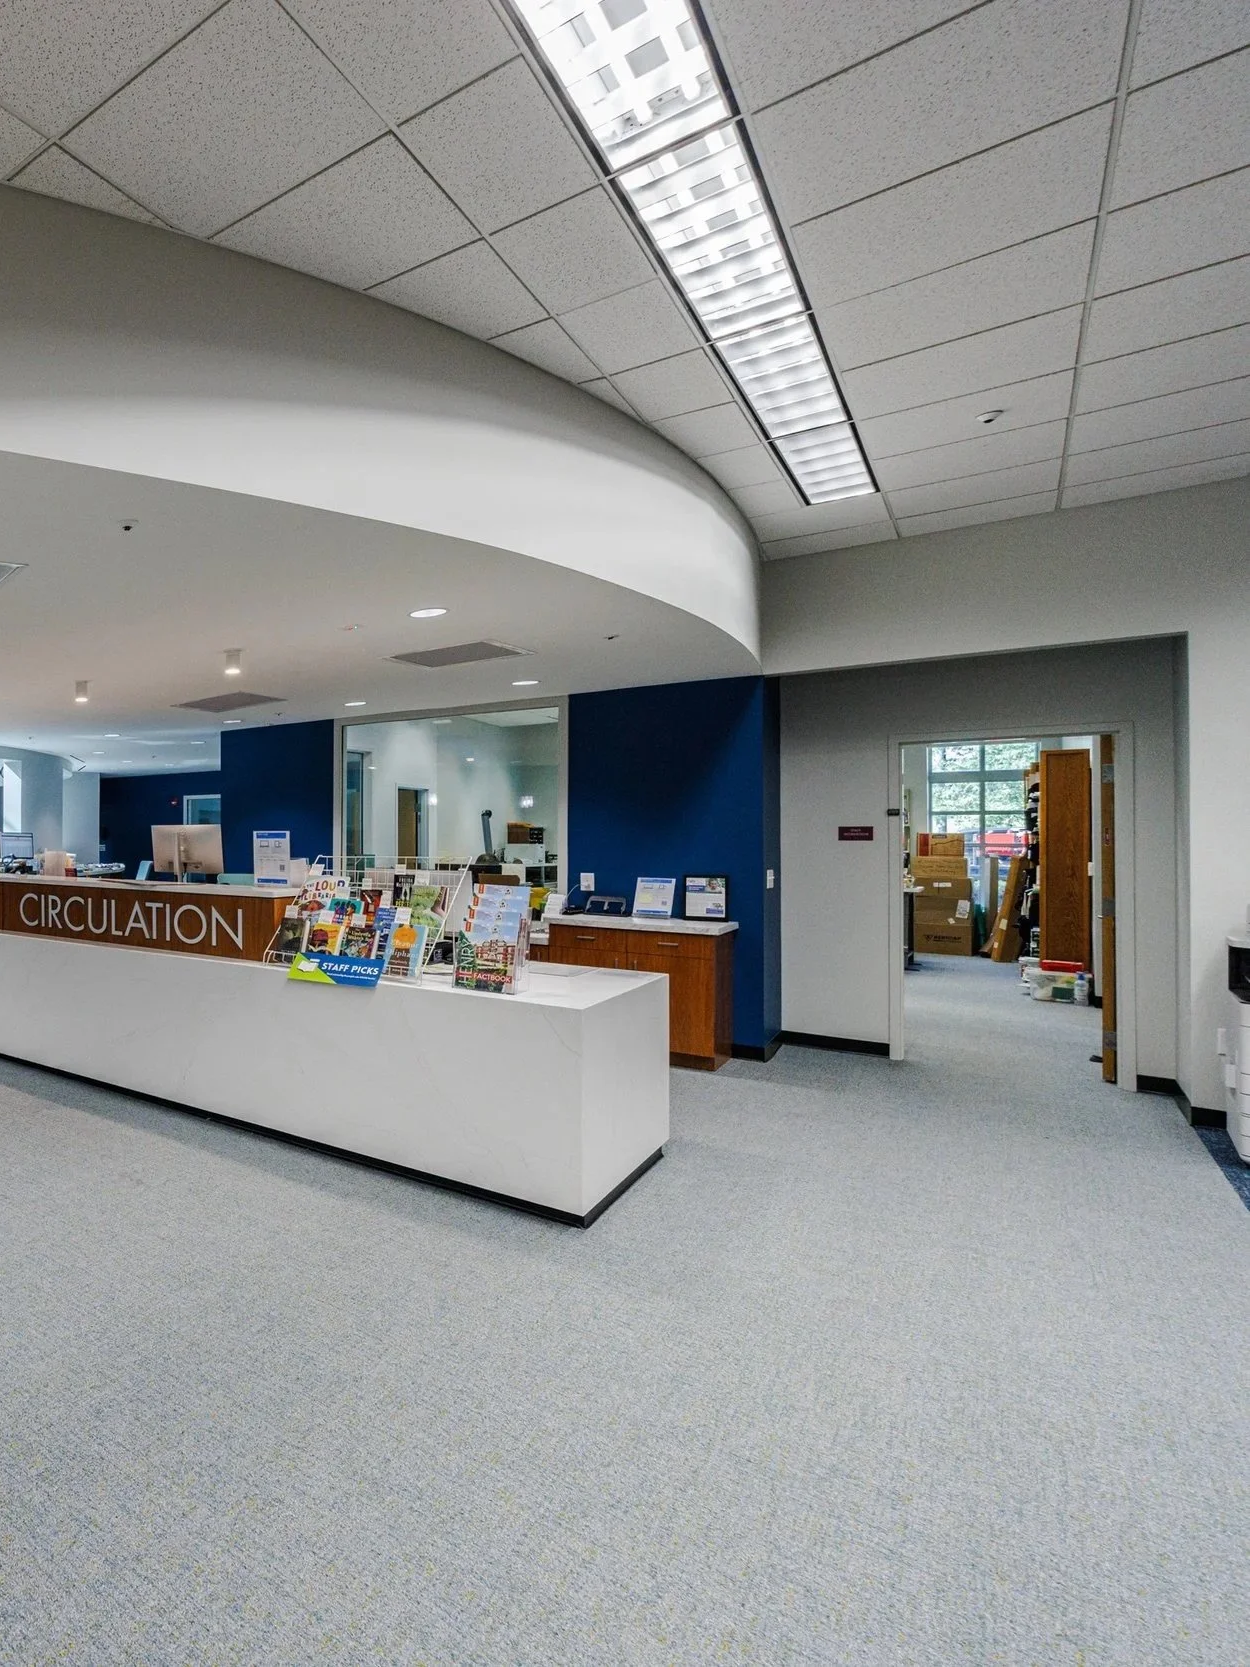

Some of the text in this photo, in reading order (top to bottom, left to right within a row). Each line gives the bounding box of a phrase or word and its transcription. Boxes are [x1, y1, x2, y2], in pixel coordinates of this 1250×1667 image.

[19, 892, 243, 950] CIRCULATION
[321, 962, 379, 975] STAFF PICKS
[458, 938, 475, 985] HENRY
[473, 972, 512, 983] FACTBOOK
